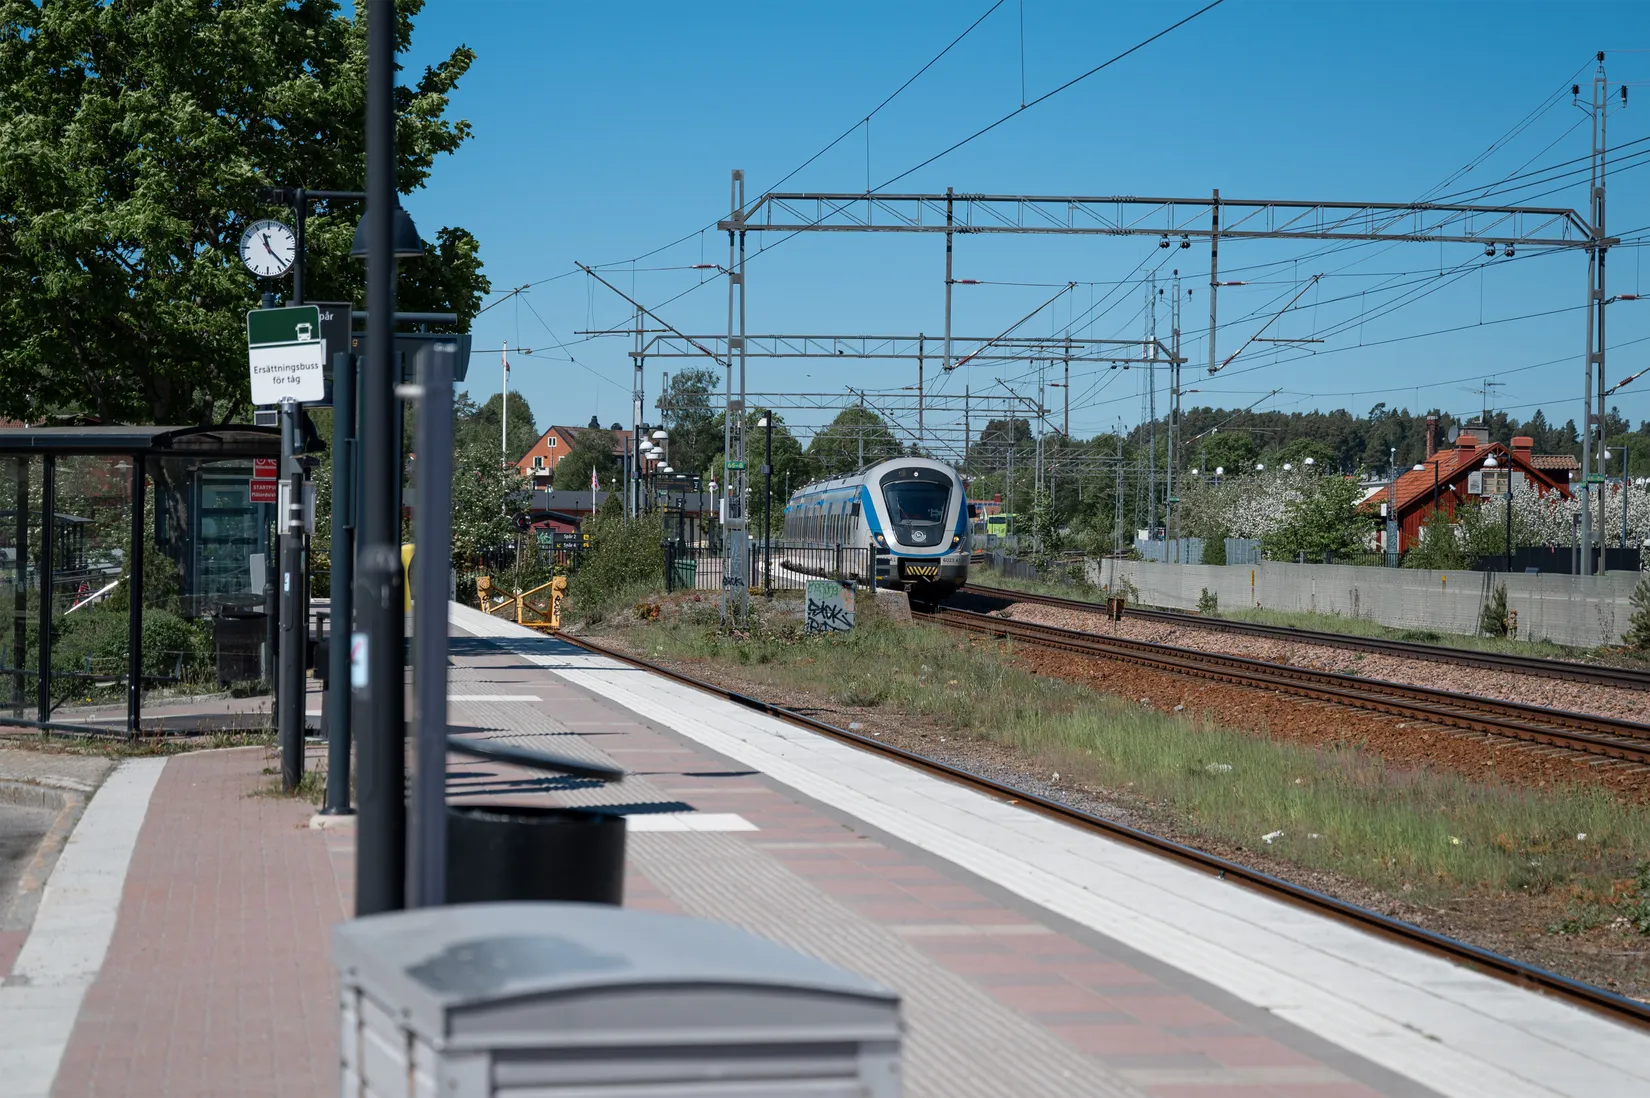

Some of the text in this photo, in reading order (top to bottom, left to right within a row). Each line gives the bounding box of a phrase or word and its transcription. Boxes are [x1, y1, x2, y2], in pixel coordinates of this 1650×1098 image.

[320, 311, 334, 322] pår
[253, 362, 319, 375] Ersättningsbuss
[273, 375, 301, 385] för tåg
